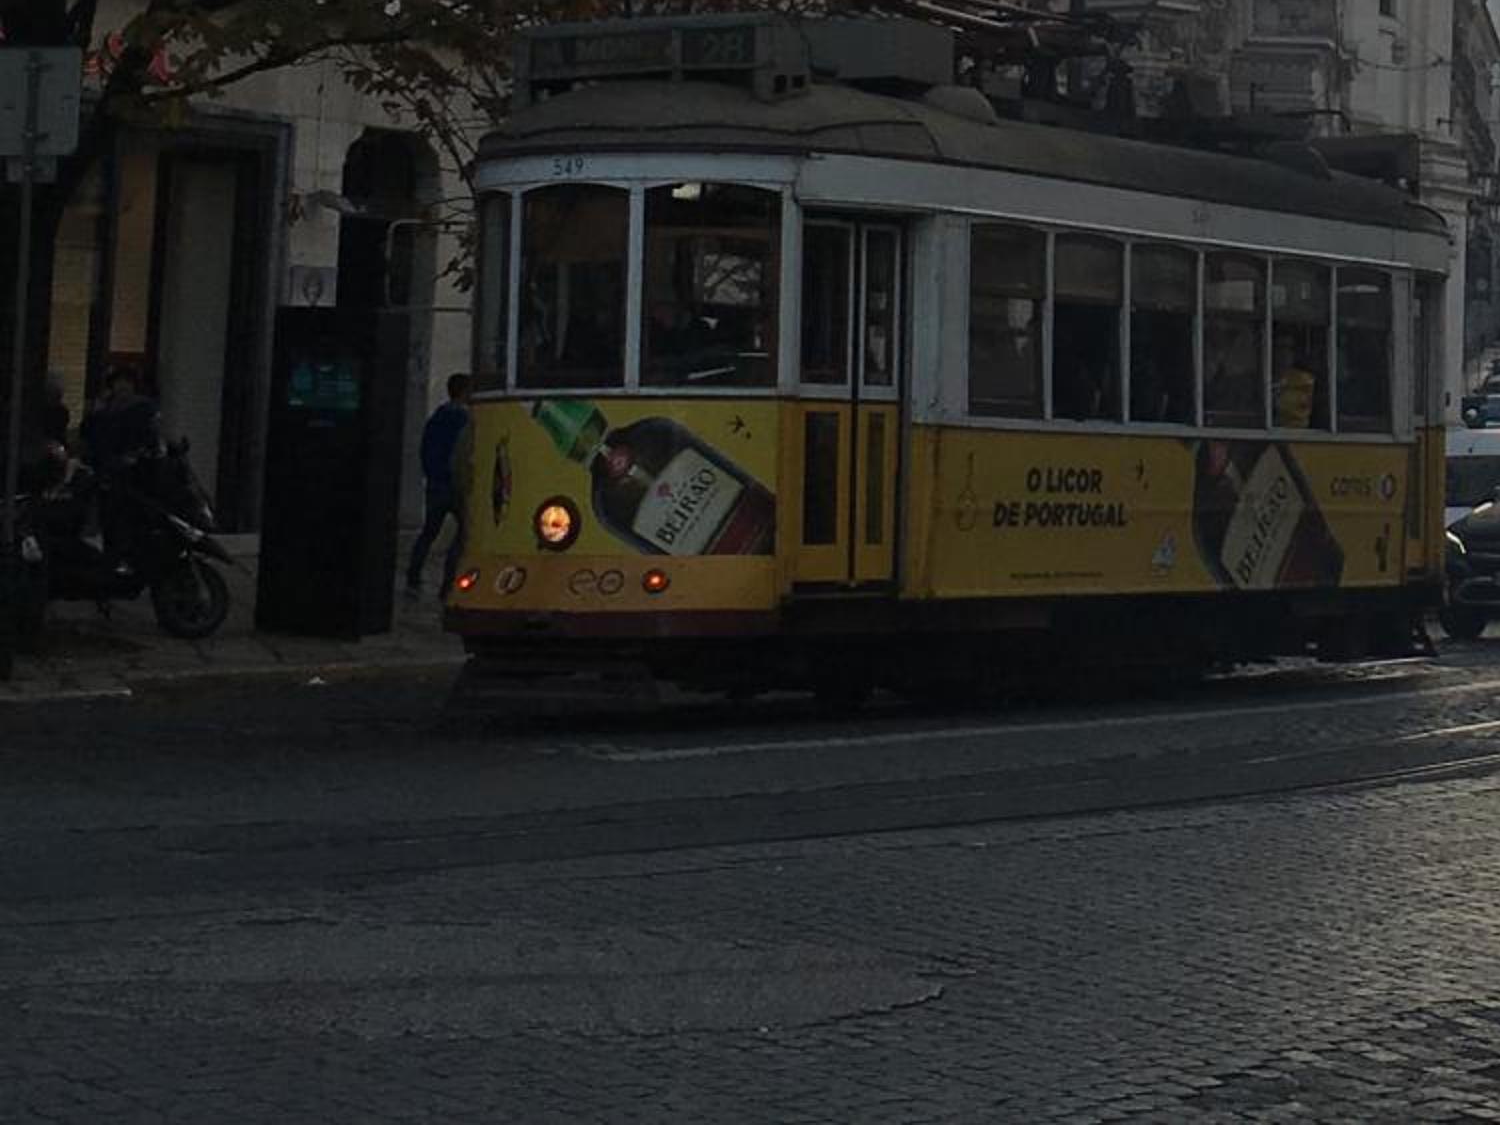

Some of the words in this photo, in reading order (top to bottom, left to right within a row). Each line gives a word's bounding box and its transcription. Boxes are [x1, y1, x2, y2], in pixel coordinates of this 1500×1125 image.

[552, 157, 584, 176] 549
[1026, 467, 1041, 492] O
[1046, 467, 1103, 493] LICOR
[655, 467, 718, 545] BEIRÃO
[993, 501, 1020, 527] DE
[1023, 502, 1128, 527] PORTUGAL
